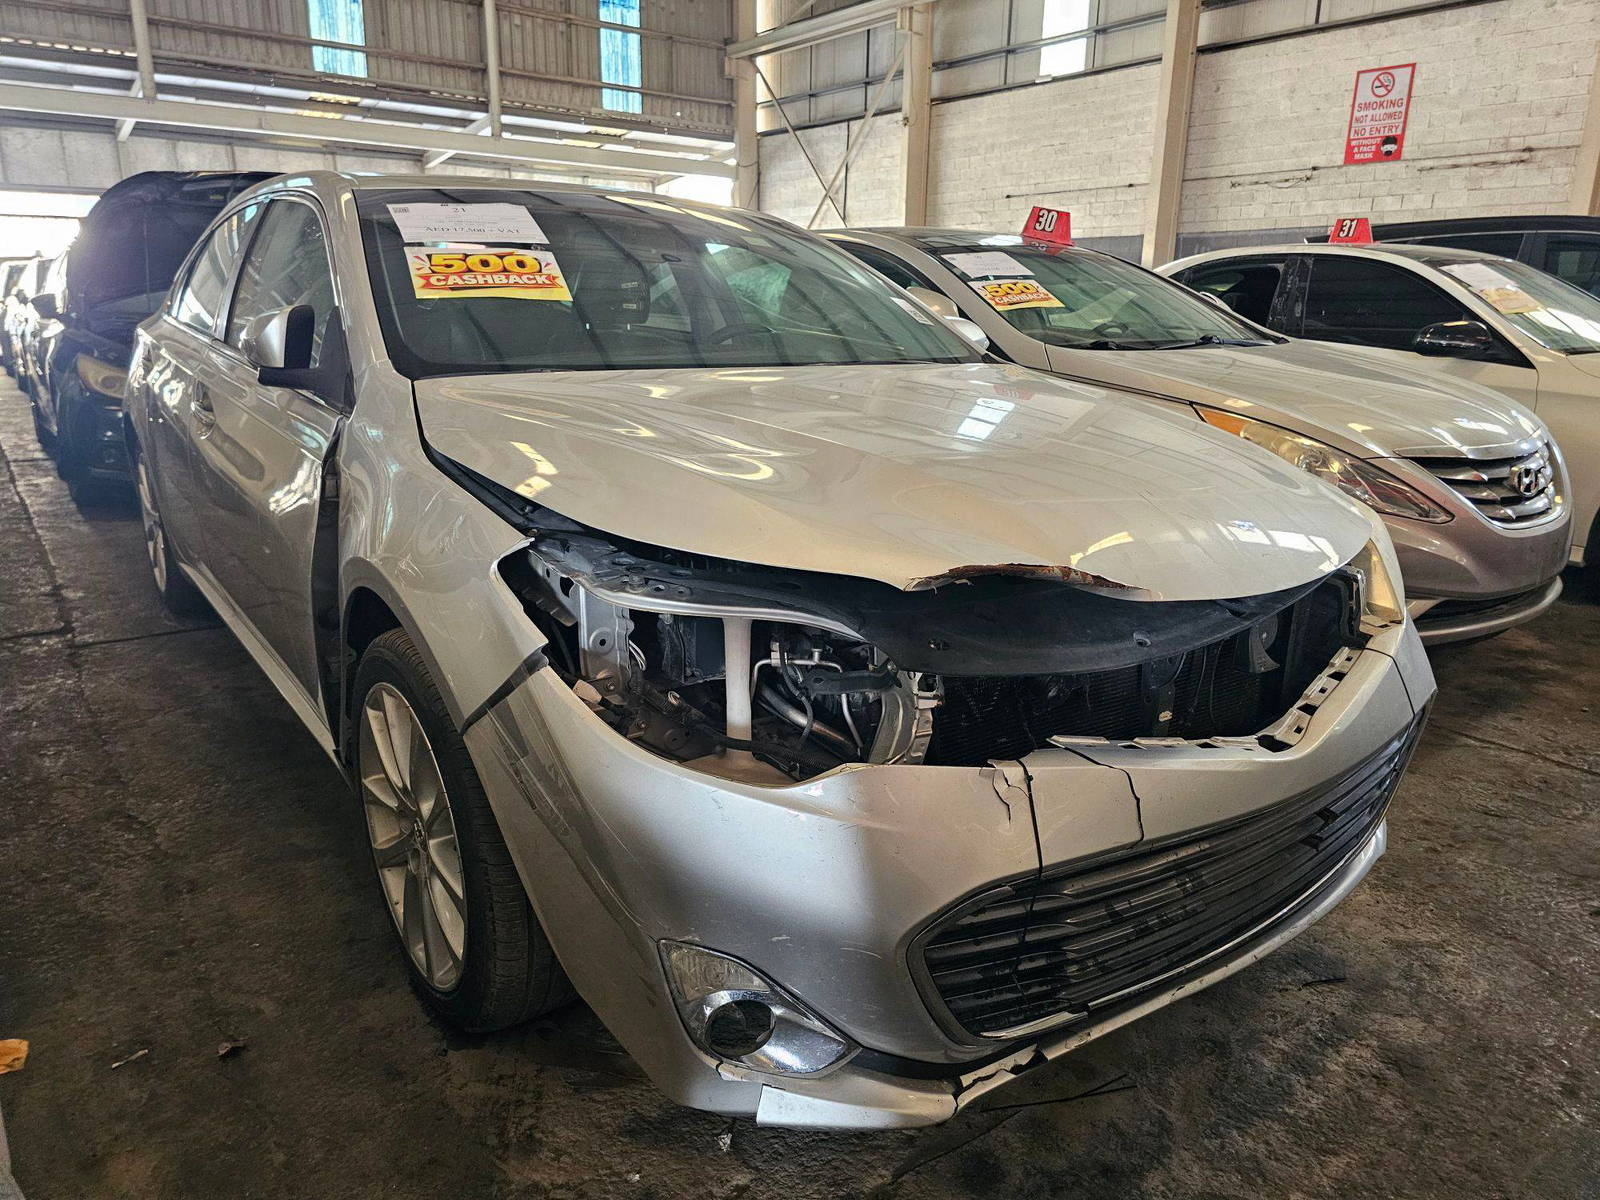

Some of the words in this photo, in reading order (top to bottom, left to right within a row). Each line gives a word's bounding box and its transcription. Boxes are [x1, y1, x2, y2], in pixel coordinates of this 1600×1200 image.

[1357, 98, 1404, 112] SMOKING
[1354, 115, 1369, 124] NOT
[1370, 111, 1403, 122] ALLOWED
[1353, 129, 1367, 137] NO
[1369, 124, 1400, 136] ENTRY
[1035, 209, 1057, 232] 30
[1339, 219, 1357, 238] 31
[430, 252, 543, 274] 500
[429, 274, 554, 286] CASHBACK
[983, 282, 1038, 296] 500
